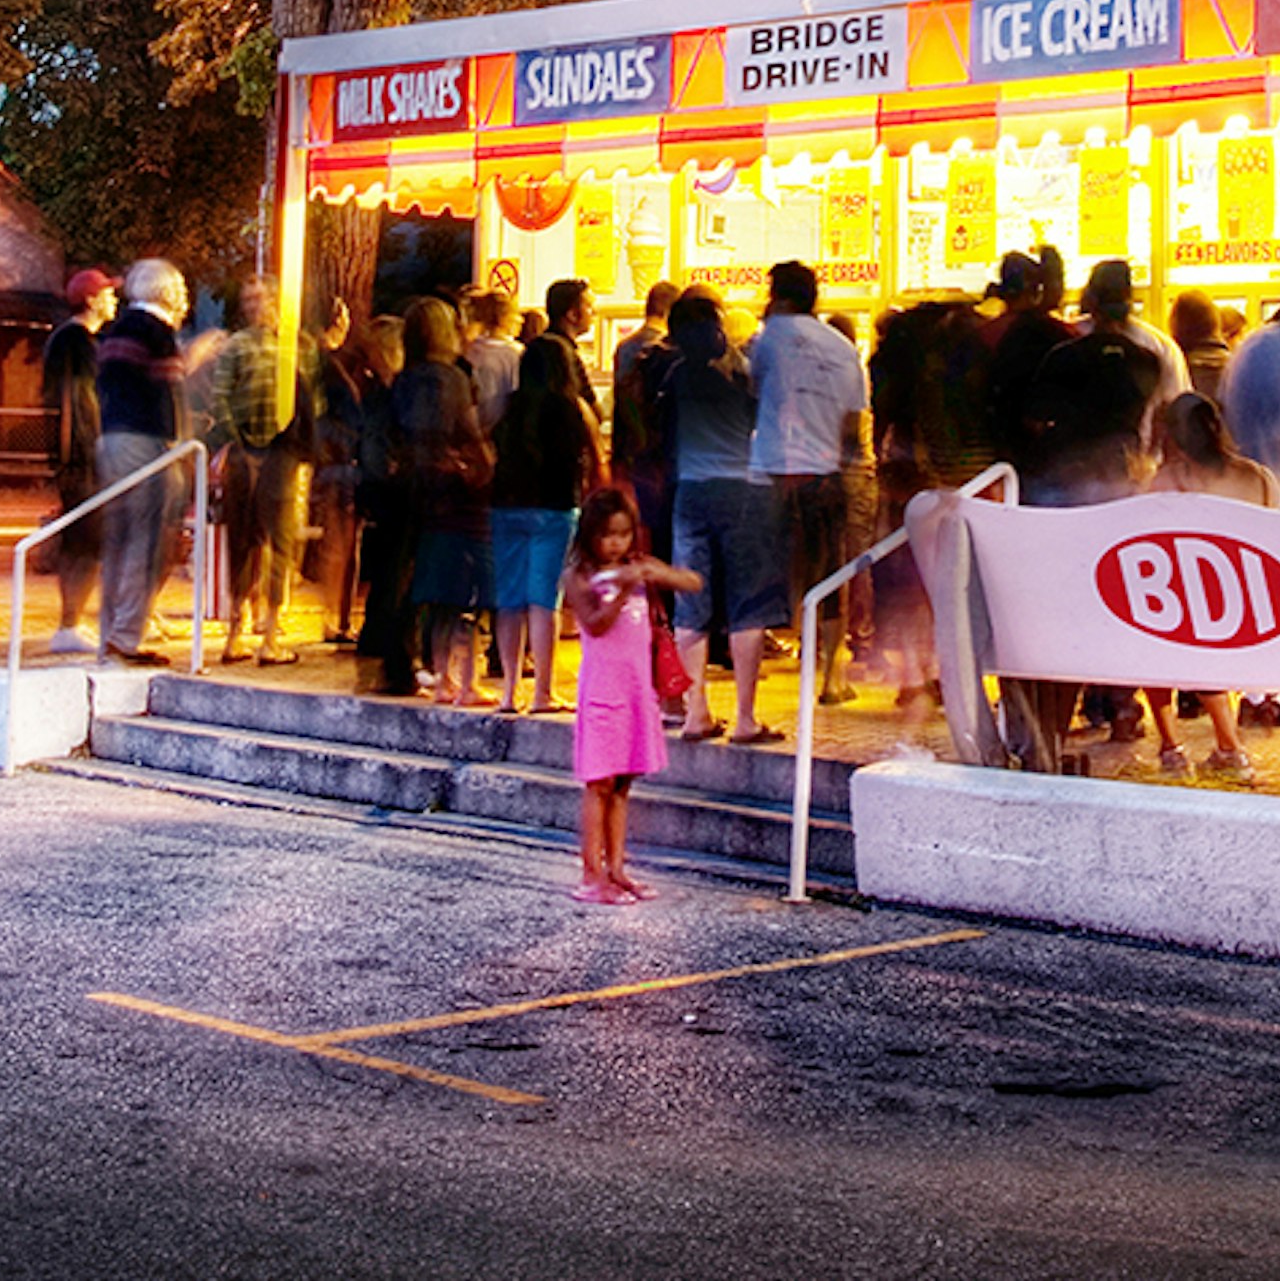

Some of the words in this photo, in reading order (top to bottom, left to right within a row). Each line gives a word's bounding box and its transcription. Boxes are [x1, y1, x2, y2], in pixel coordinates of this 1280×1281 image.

[751, 15, 884, 55] BRIDGE
[982, 1, 1033, 64] ICE
[338, 76, 385, 129] MILK
[388, 65, 462, 124] SHAKES
[526, 46, 655, 110] SUNDAES
[742, 51, 889, 92] DRIVE-IN
[832, 262, 880, 283] CREAM
[1204, 241, 1271, 263] FLAVORS
[1117, 537, 1276, 641] BDI
